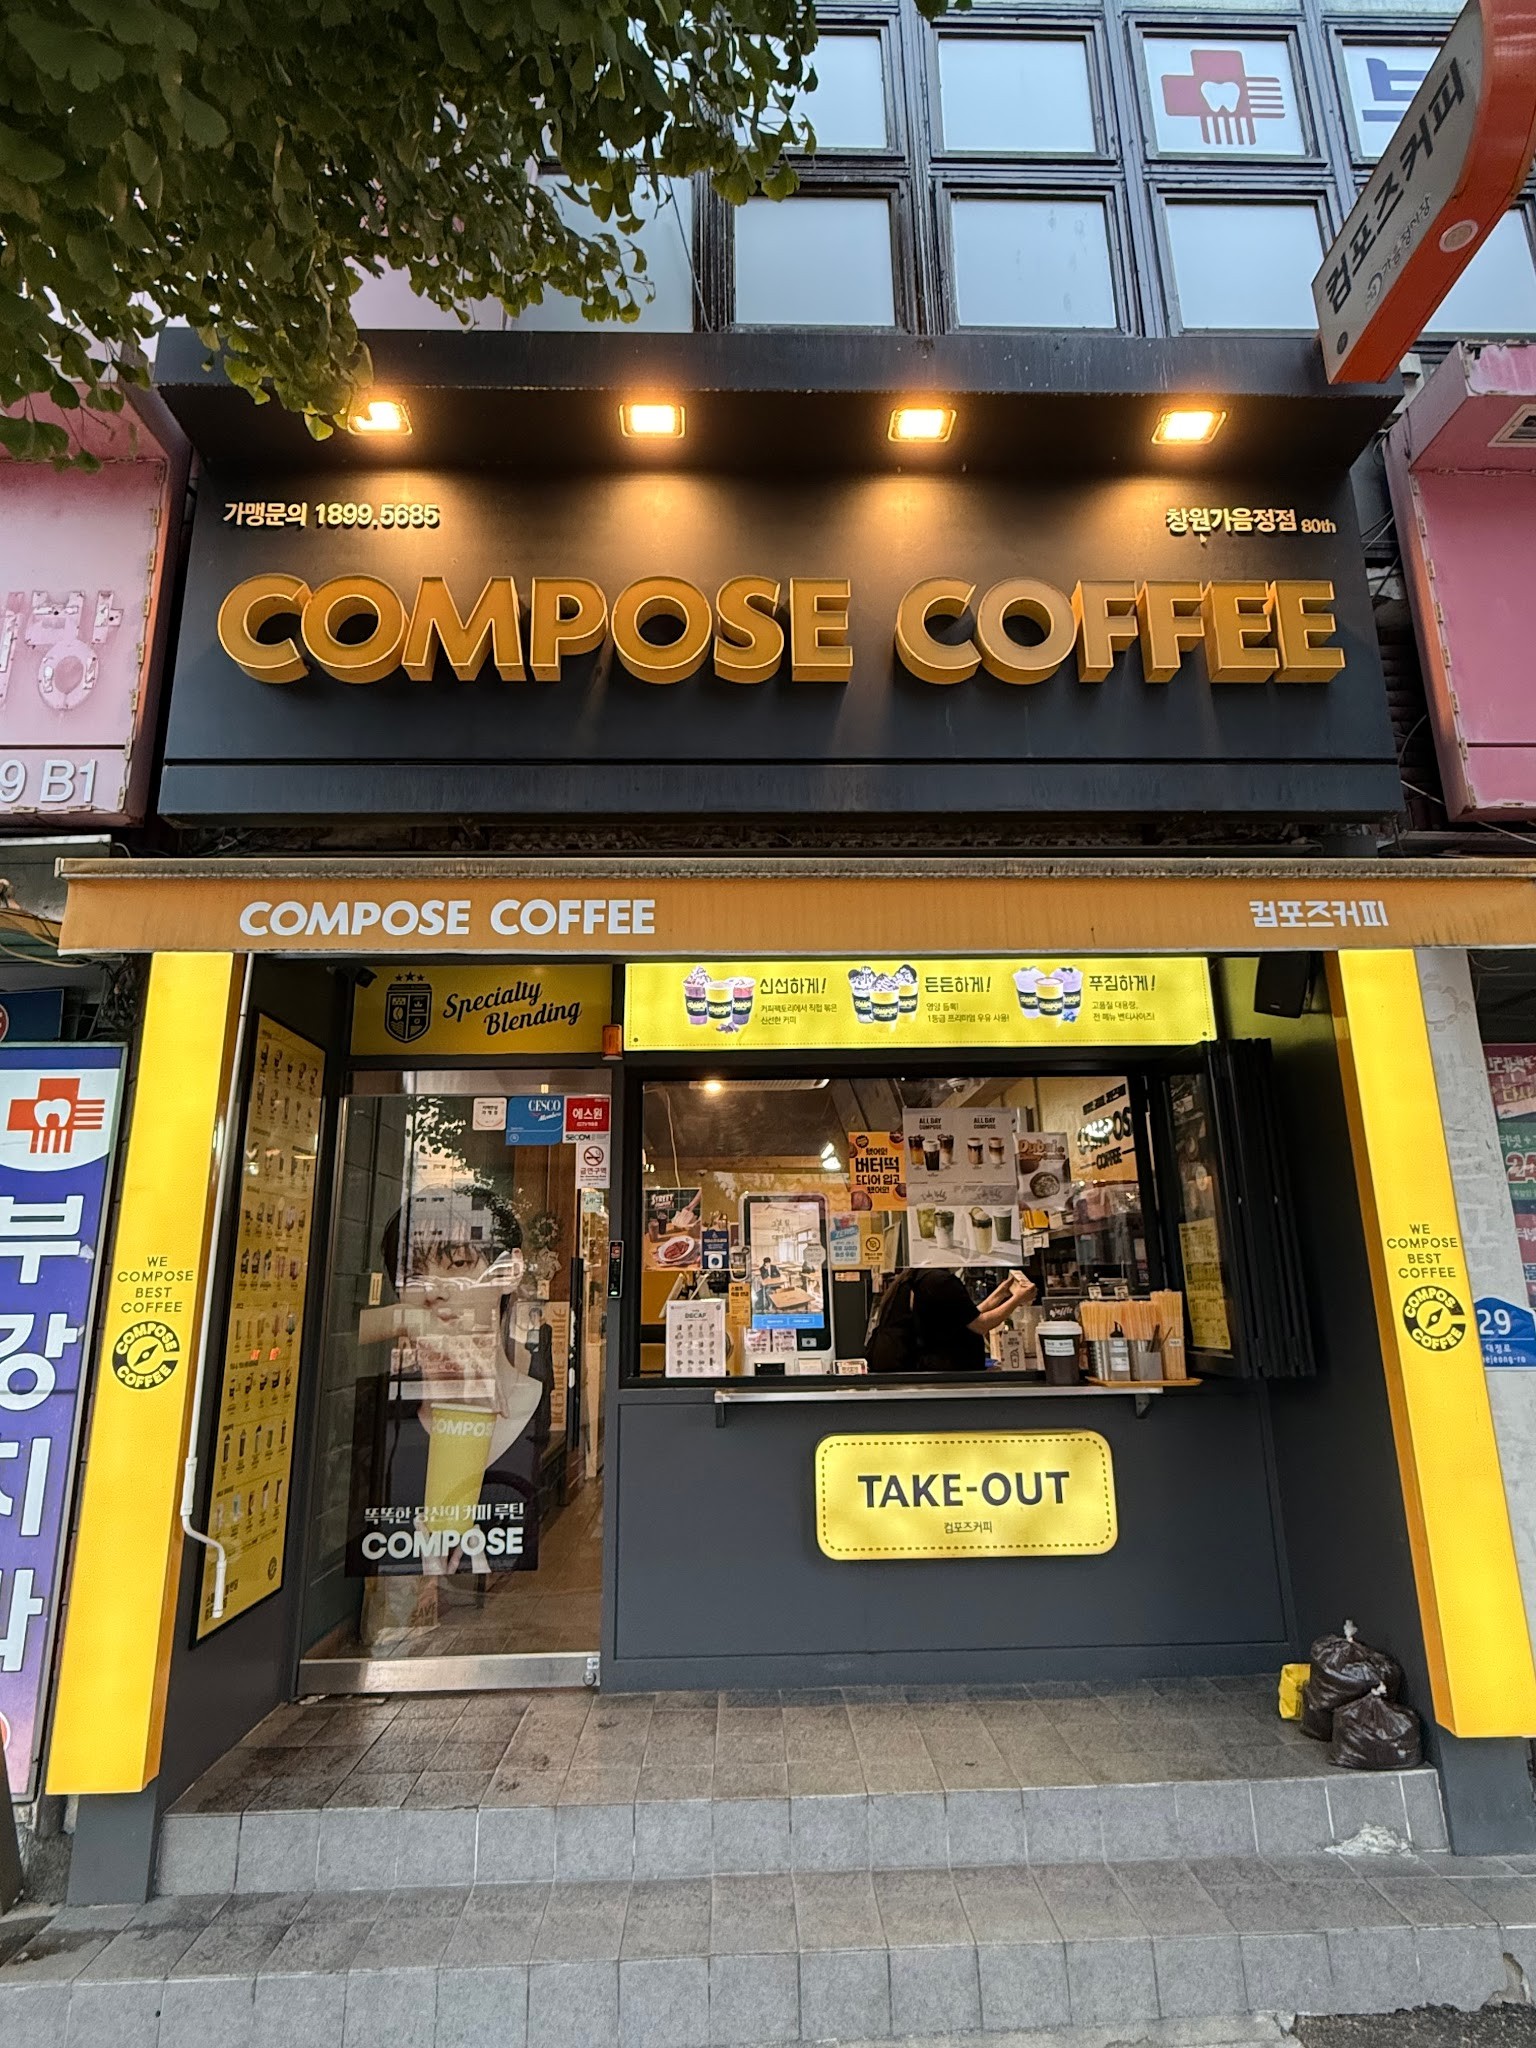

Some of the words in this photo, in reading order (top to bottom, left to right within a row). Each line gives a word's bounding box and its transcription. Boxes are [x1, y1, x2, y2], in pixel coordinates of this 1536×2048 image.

[1325, 57, 1465, 314] 컴포즈커피
[223, 502, 307, 526] 가맹문의
[315, 503, 440, 527] 1899.5685
[1166, 507, 1297, 532] 창원가음정점
[1301, 518, 1337, 534] 80th
[217, 572, 854, 684] COMPOSE
[895, 577, 1345, 685] COFFEE
[40, 758, 98, 803] B1
[239, 899, 471, 937] COMPOSE
[490, 898, 656, 935] COFFEE
[1249, 900, 1389, 928] 컴포즈커피
[760, 977, 827, 994] 신선하게!
[925, 976, 992, 993] 든든하게!
[1089, 974, 1156, 991] 푸짐하게!
[443, 981, 543, 1022] Specialty
[484, 1002, 582, 1036] Blending
[528, 1099, 561, 1112] CESCO
[572, 1107, 603, 1120] 에스원
[580, 1167, 608, 1175] 금연구역
[855, 1157, 900, 1173] 버터떡
[1409, 1223, 1430, 1234] WE
[1386, 1237, 1458, 1249] COMPOSE
[146, 1256, 168, 1267] WE
[1407, 1253, 1441, 1264] BEST
[117, 1270, 194, 1282] COMPOSE
[1398, 1267, 1456, 1278] COFFEE
[135, 1287, 172, 1298] BEST
[121, 1301, 182, 1313] COFFEE
[1477, 1309, 1511, 1335] 29
[115, 1322, 178, 1355] COMPOSE
[1412, 1327, 1463, 1350] COFFEE
[117, 1364, 172, 1388] COFFEE
[857, 1471, 1070, 1508] TAKE-OUT
[364, 1507, 411, 1525] 똑똑한
[414, 1504, 459, 1522] 당신의
[463, 1503, 492, 1520] 커피
[494, 1502, 524, 1520] 루틴
[943, 1521, 993, 1534] 컴포즈커피
[361, 1526, 524, 1561] COMPOSE
